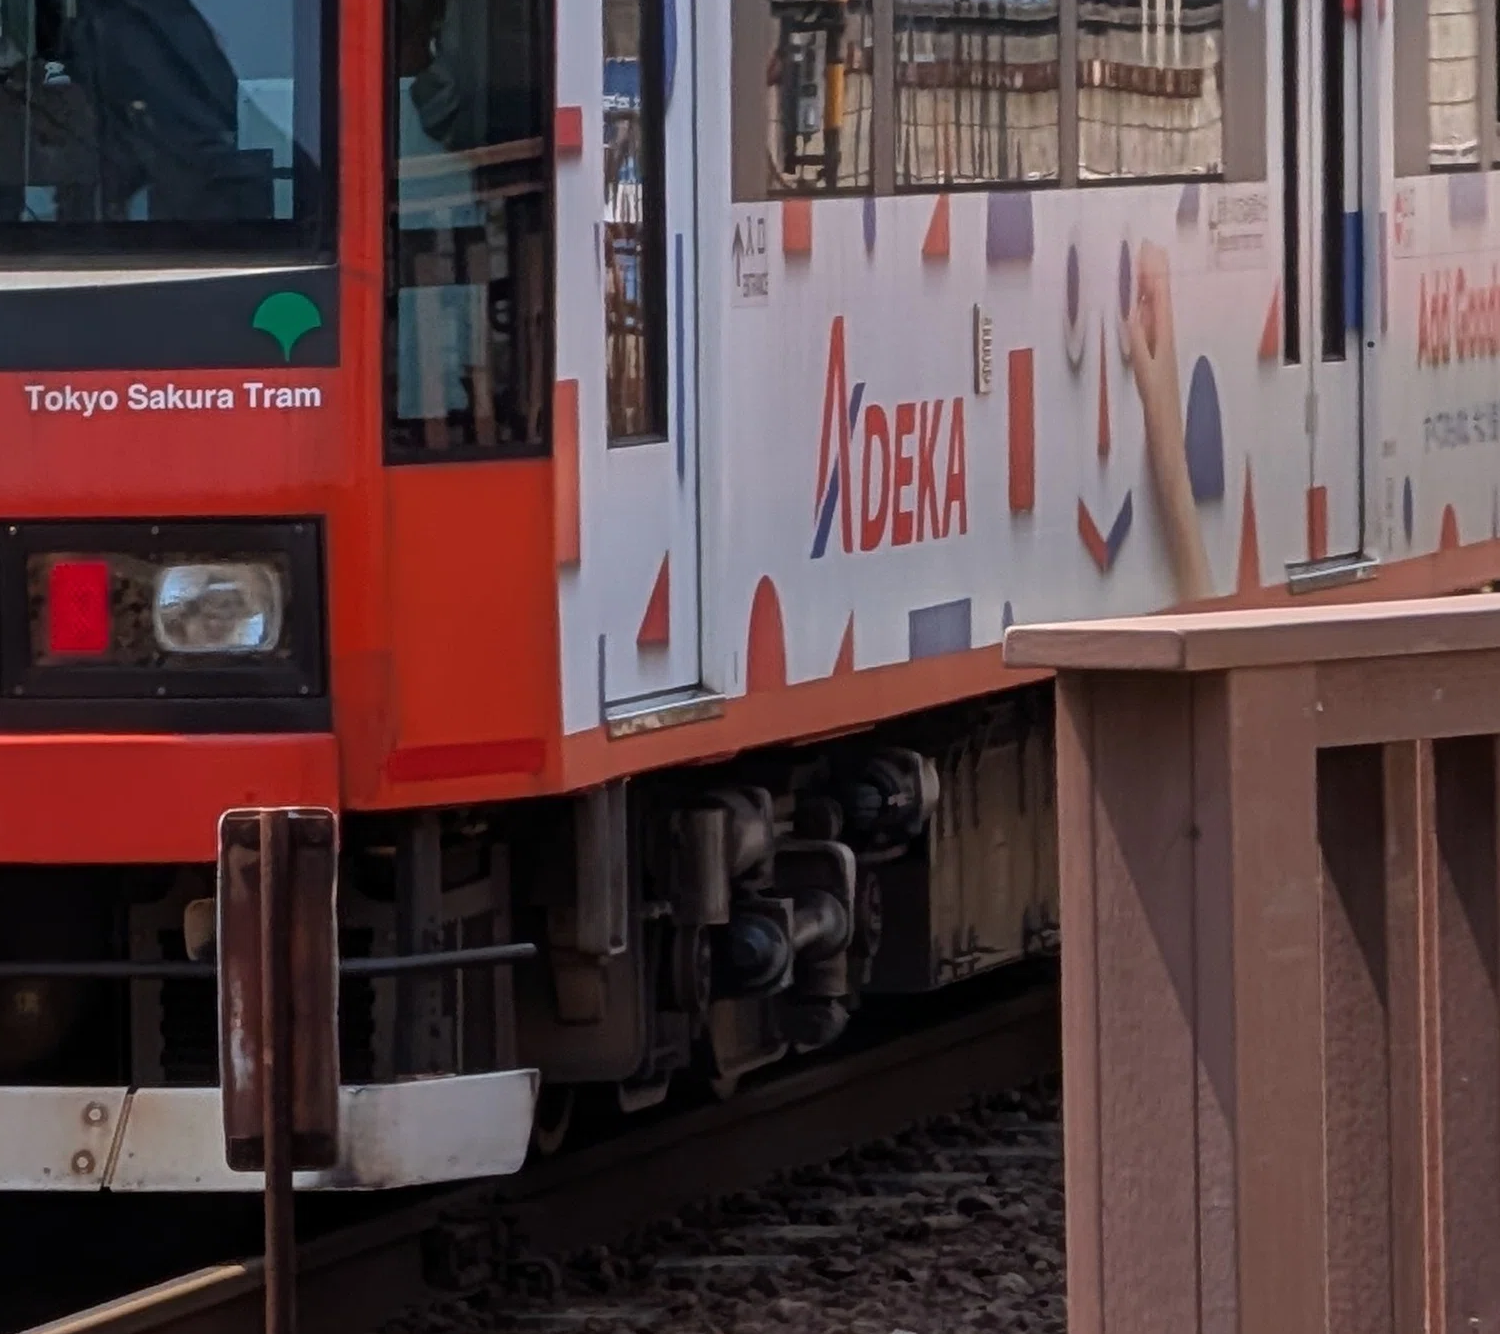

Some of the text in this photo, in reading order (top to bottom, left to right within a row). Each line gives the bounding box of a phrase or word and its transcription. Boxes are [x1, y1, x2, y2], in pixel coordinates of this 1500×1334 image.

[24, 382, 322, 418] Tokyo Sakura Tram
[810, 315, 968, 559] ADEKA
